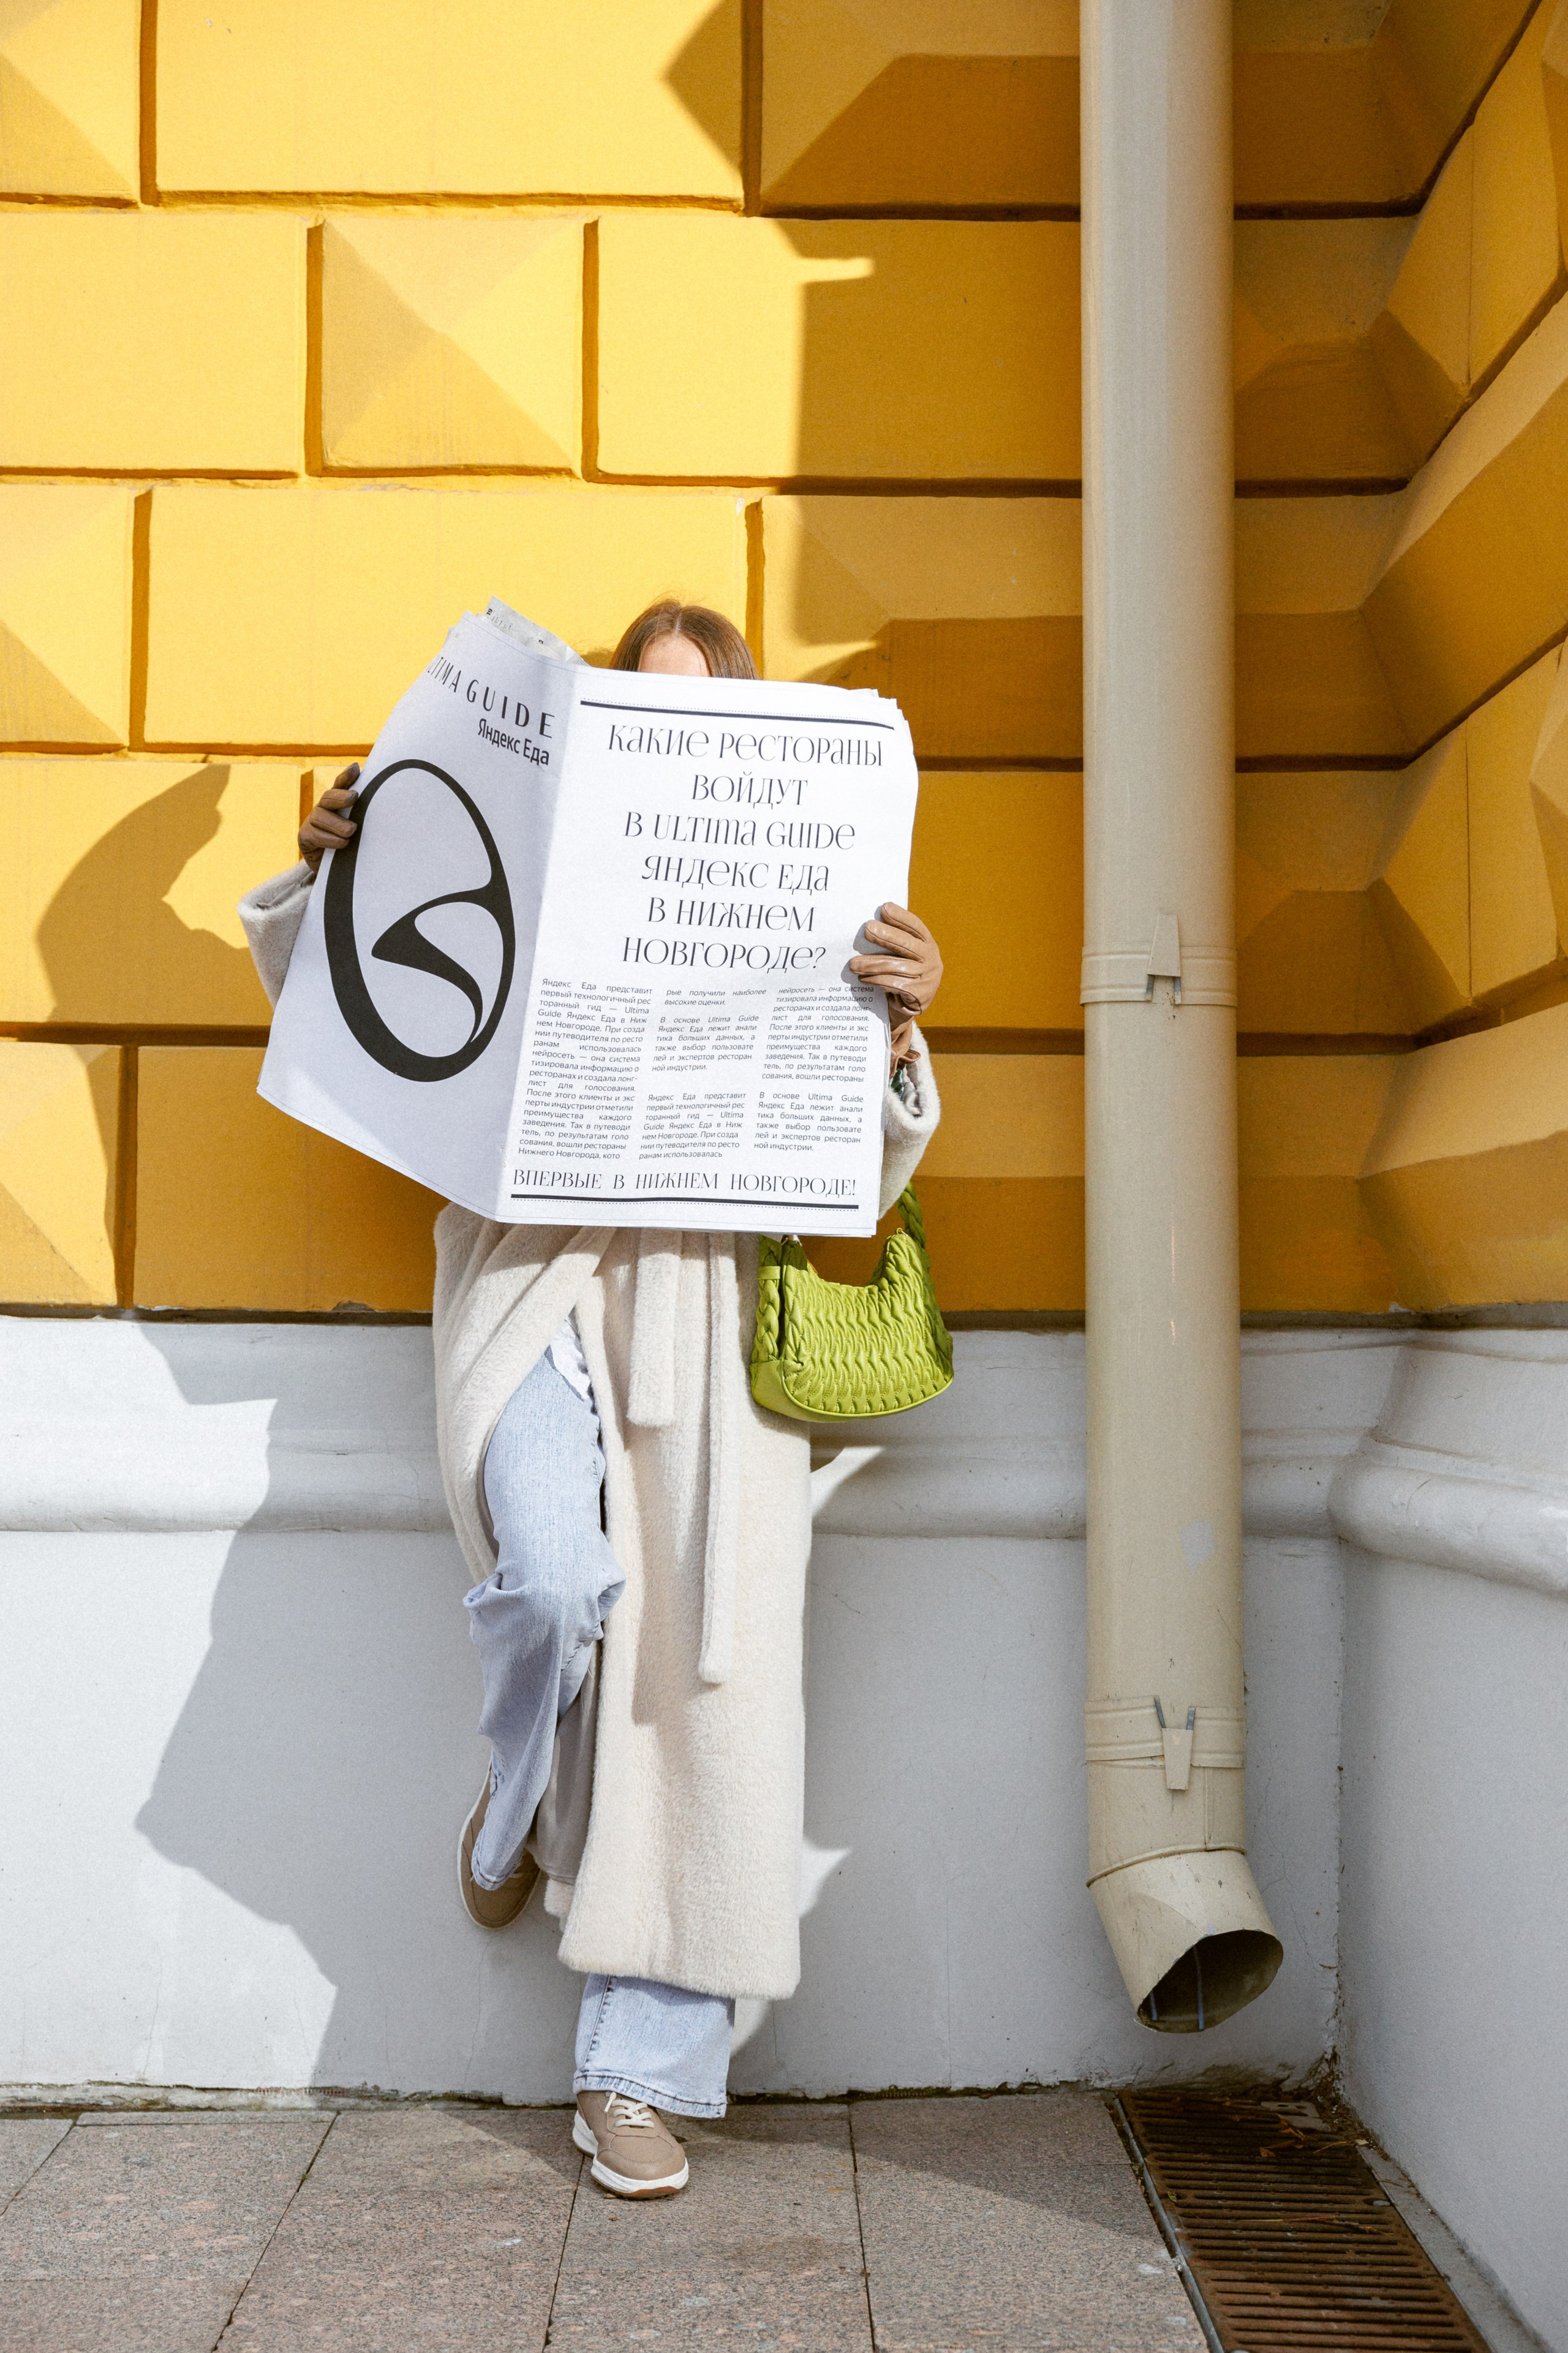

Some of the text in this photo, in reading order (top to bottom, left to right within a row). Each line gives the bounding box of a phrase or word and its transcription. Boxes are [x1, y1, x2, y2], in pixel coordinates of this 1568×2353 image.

[467, 679, 555, 738] GUIDE
[478, 718, 550, 766] Яндекс Еда
[542, 978, 653, 994] Яндекс Еда представит
[574, 993, 636, 1003] технологичный
[540, 1000, 579, 1009] торанный
[538, 1008, 562, 1018] Guide
[566, 1011, 595, 1021] Яндекс
[601, 1014, 616, 1023] Еда
[605, 1025, 621, 1034] При
[552, 1032, 609, 1042] путеводителя
[532, 1049, 575, 1059] нейросеть
[532, 1060, 578, 1070] тизировала
[580, 1064, 633, 1073] информацию
[529, 1070, 576, 1079] ресторанах
[527, 1088, 552, 1097] После
[841, 1094, 864, 1103] Guide
[551, 1102, 595, 1111] индустрии
[524, 1110, 584, 1119] преимущества
[646, 1112, 680, 1121] торанный
[780, 1112, 814, 1120] больших
[518, 1147, 554, 1156] Нижнего
[513, 1169, 856, 1198] ВПЕРВЫЕ В НИЖНЕМ НОВГОРОДЕ!
